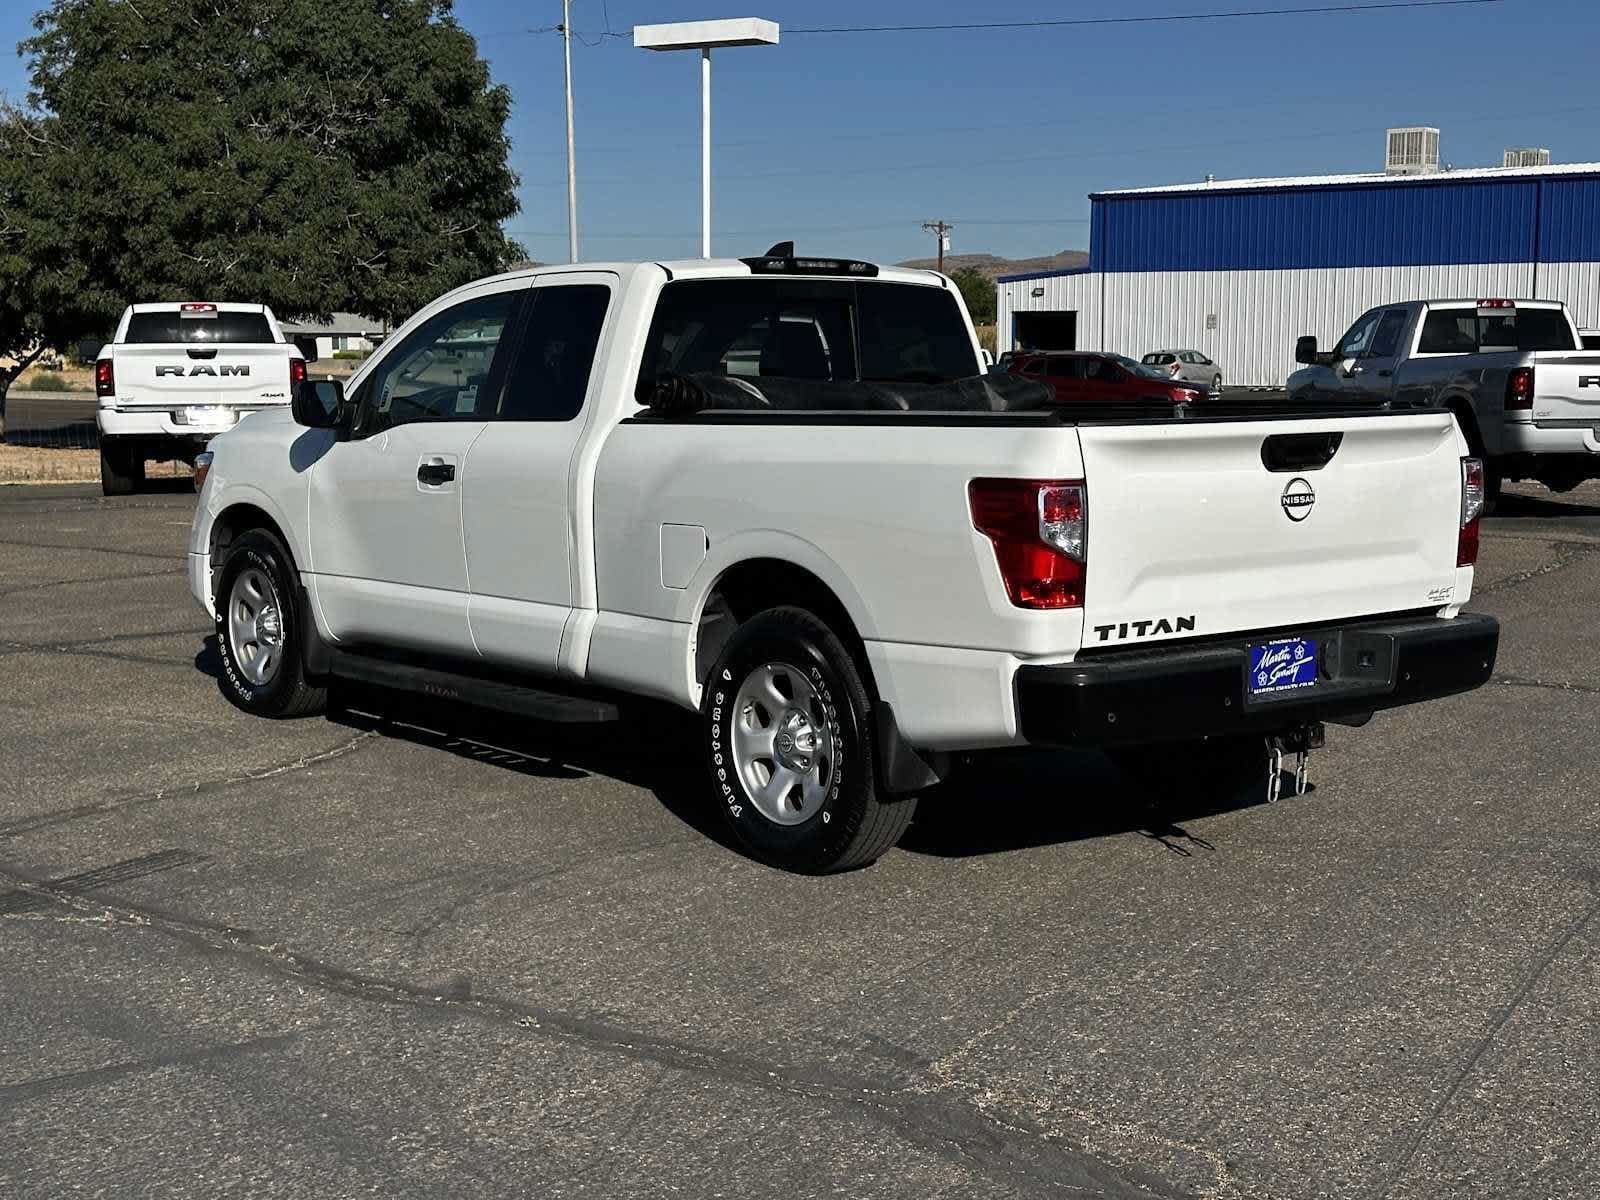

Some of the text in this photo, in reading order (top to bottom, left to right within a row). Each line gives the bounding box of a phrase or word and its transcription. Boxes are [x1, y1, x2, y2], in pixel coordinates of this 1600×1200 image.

[155, 365, 250, 377] RAM
[1282, 495, 1315, 505] NISSAN
[1094, 615, 1195, 641] TITAN
[1253, 645, 1291, 673] Martin
[712, 691, 743, 818] Firestone
